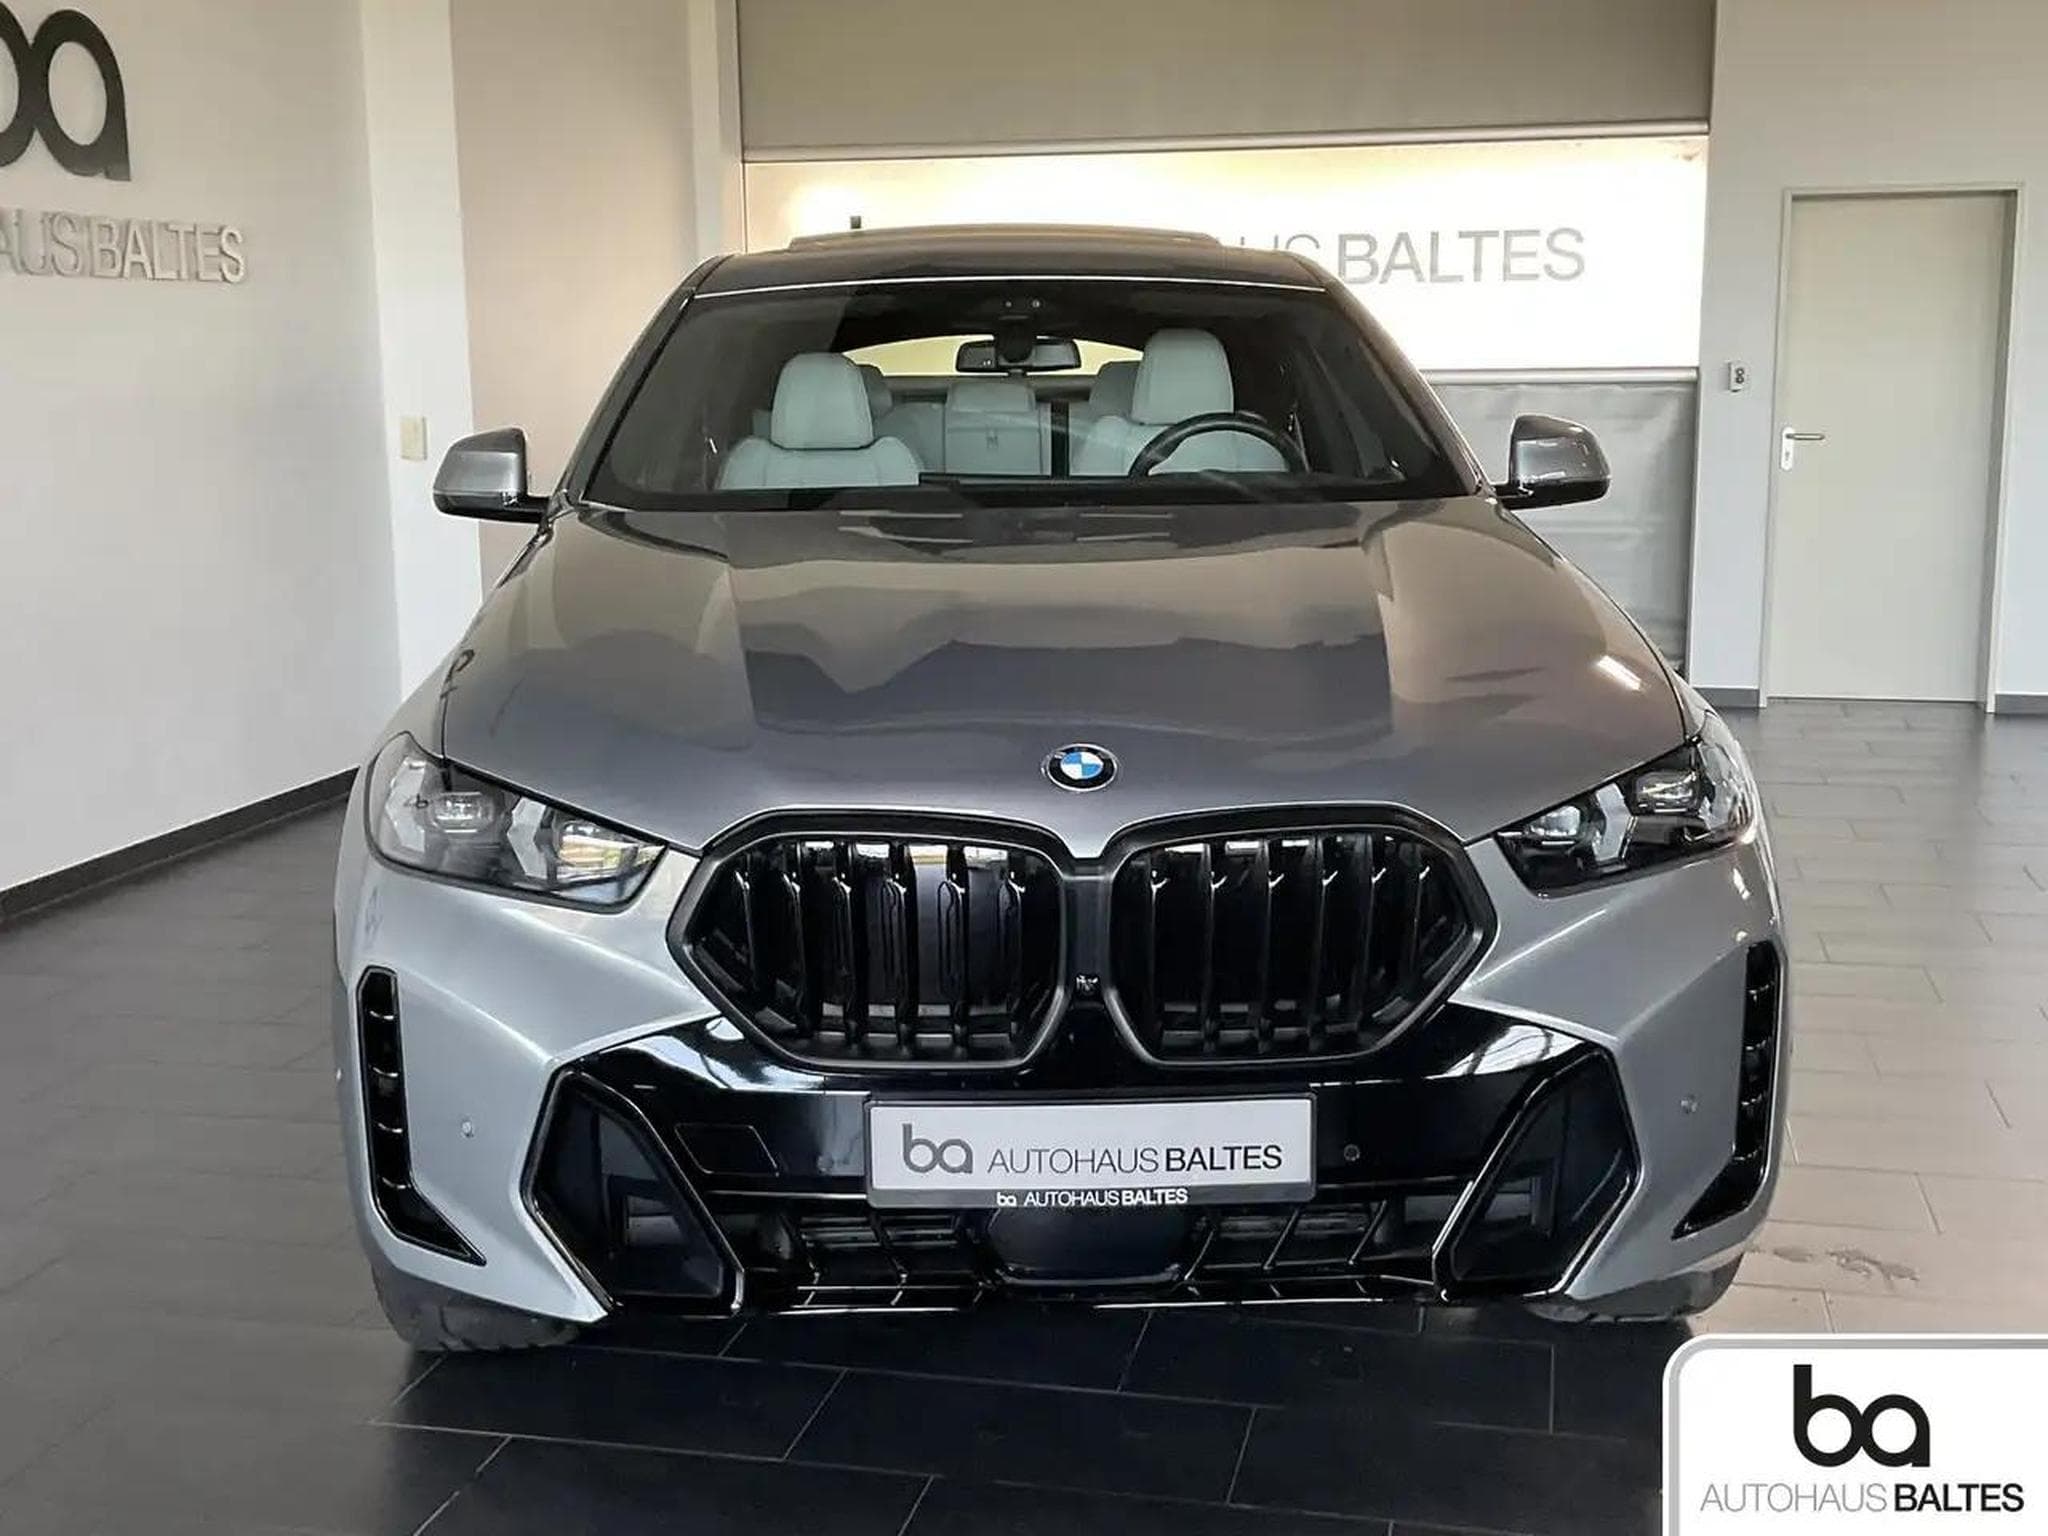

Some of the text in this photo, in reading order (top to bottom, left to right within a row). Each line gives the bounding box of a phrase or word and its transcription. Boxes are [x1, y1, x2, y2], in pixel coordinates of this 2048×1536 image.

[88, 217, 245, 283] BALTES
[1338, 228, 1585, 284] BALTES
[902, 1123, 1282, 1174] ba AUTOHAUS BALTES
[1024, 1191, 1120, 1206] AUTOHAUS
[1121, 1188, 1188, 1205] BALTES
